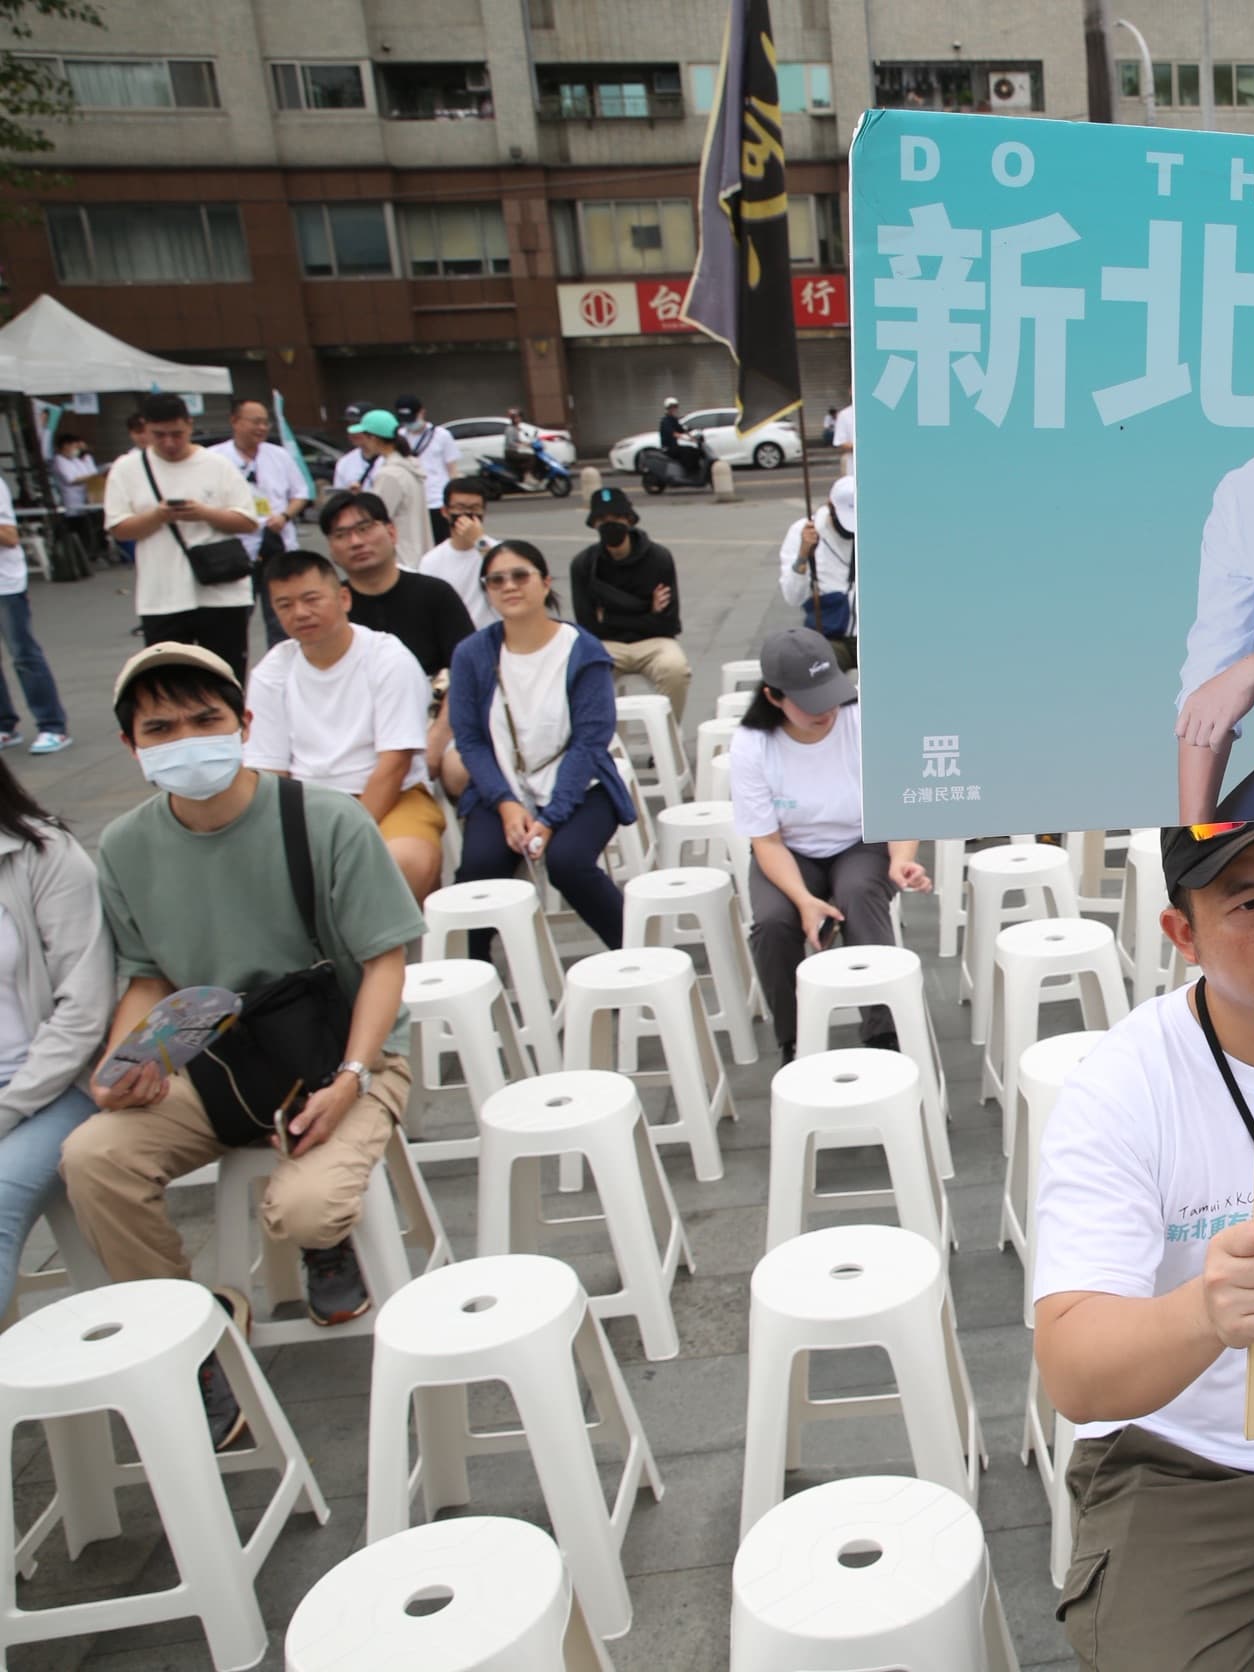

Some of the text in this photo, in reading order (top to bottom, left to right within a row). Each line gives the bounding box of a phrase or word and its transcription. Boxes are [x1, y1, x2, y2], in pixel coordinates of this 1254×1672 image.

[900, 135, 1035, 188] DO
[903, 785, 981, 804] 台灣民眾黨
